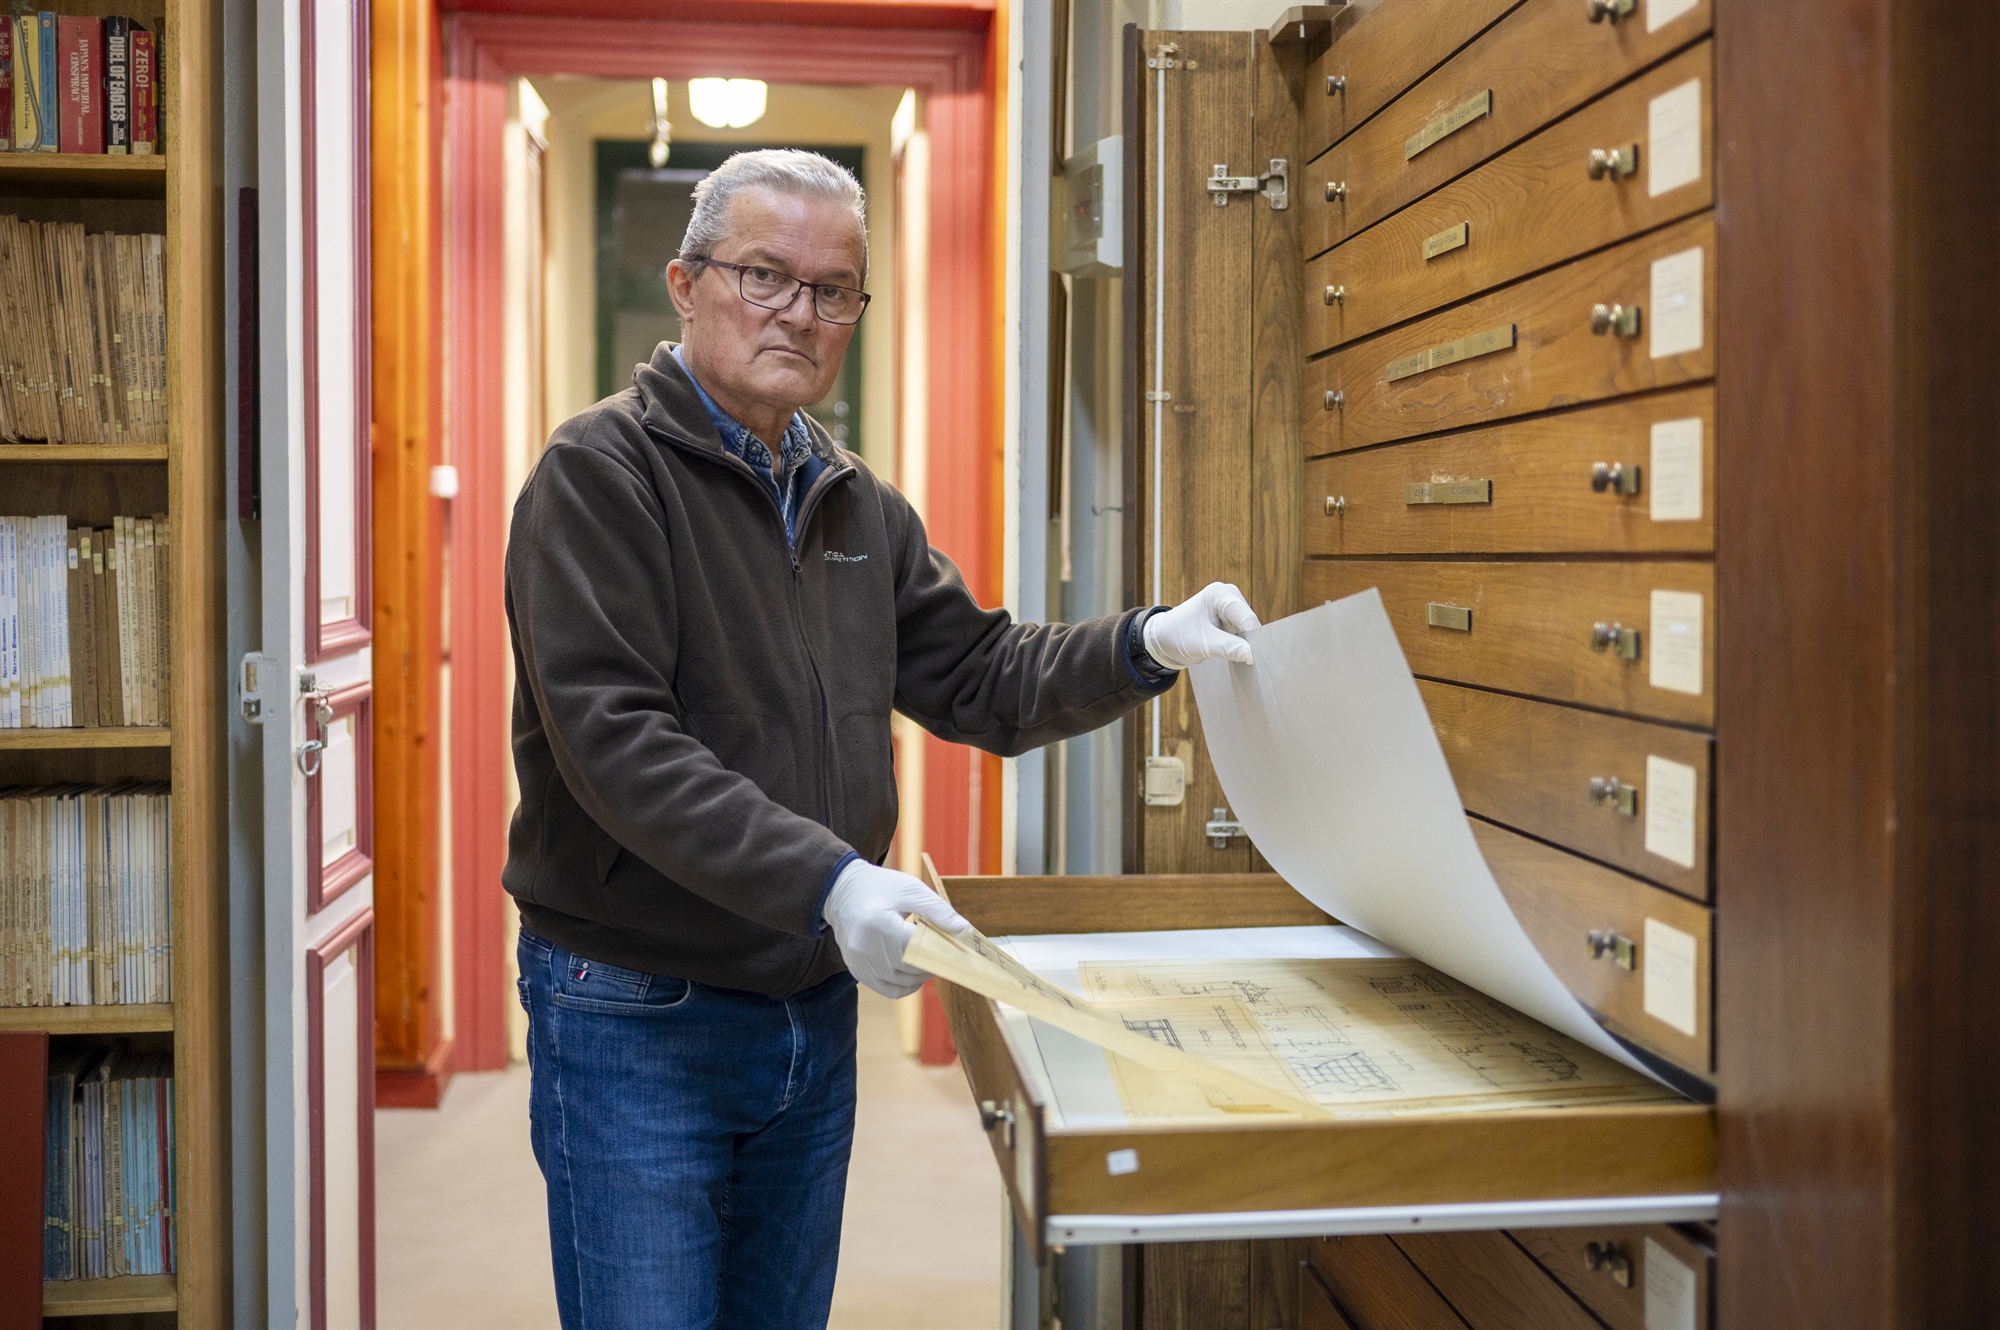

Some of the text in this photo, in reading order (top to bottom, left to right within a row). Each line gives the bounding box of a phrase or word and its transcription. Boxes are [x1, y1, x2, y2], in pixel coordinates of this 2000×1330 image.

[109, 36, 126, 64] DUEL
[136, 49, 149, 88] ZERO!
[70, 52, 80, 102] CONSPIRACY
[79, 39, 90, 116] JAPAN'S IMPERIAL
[110, 65, 126, 81] OF
[110, 81, 126, 122] EAGLES
